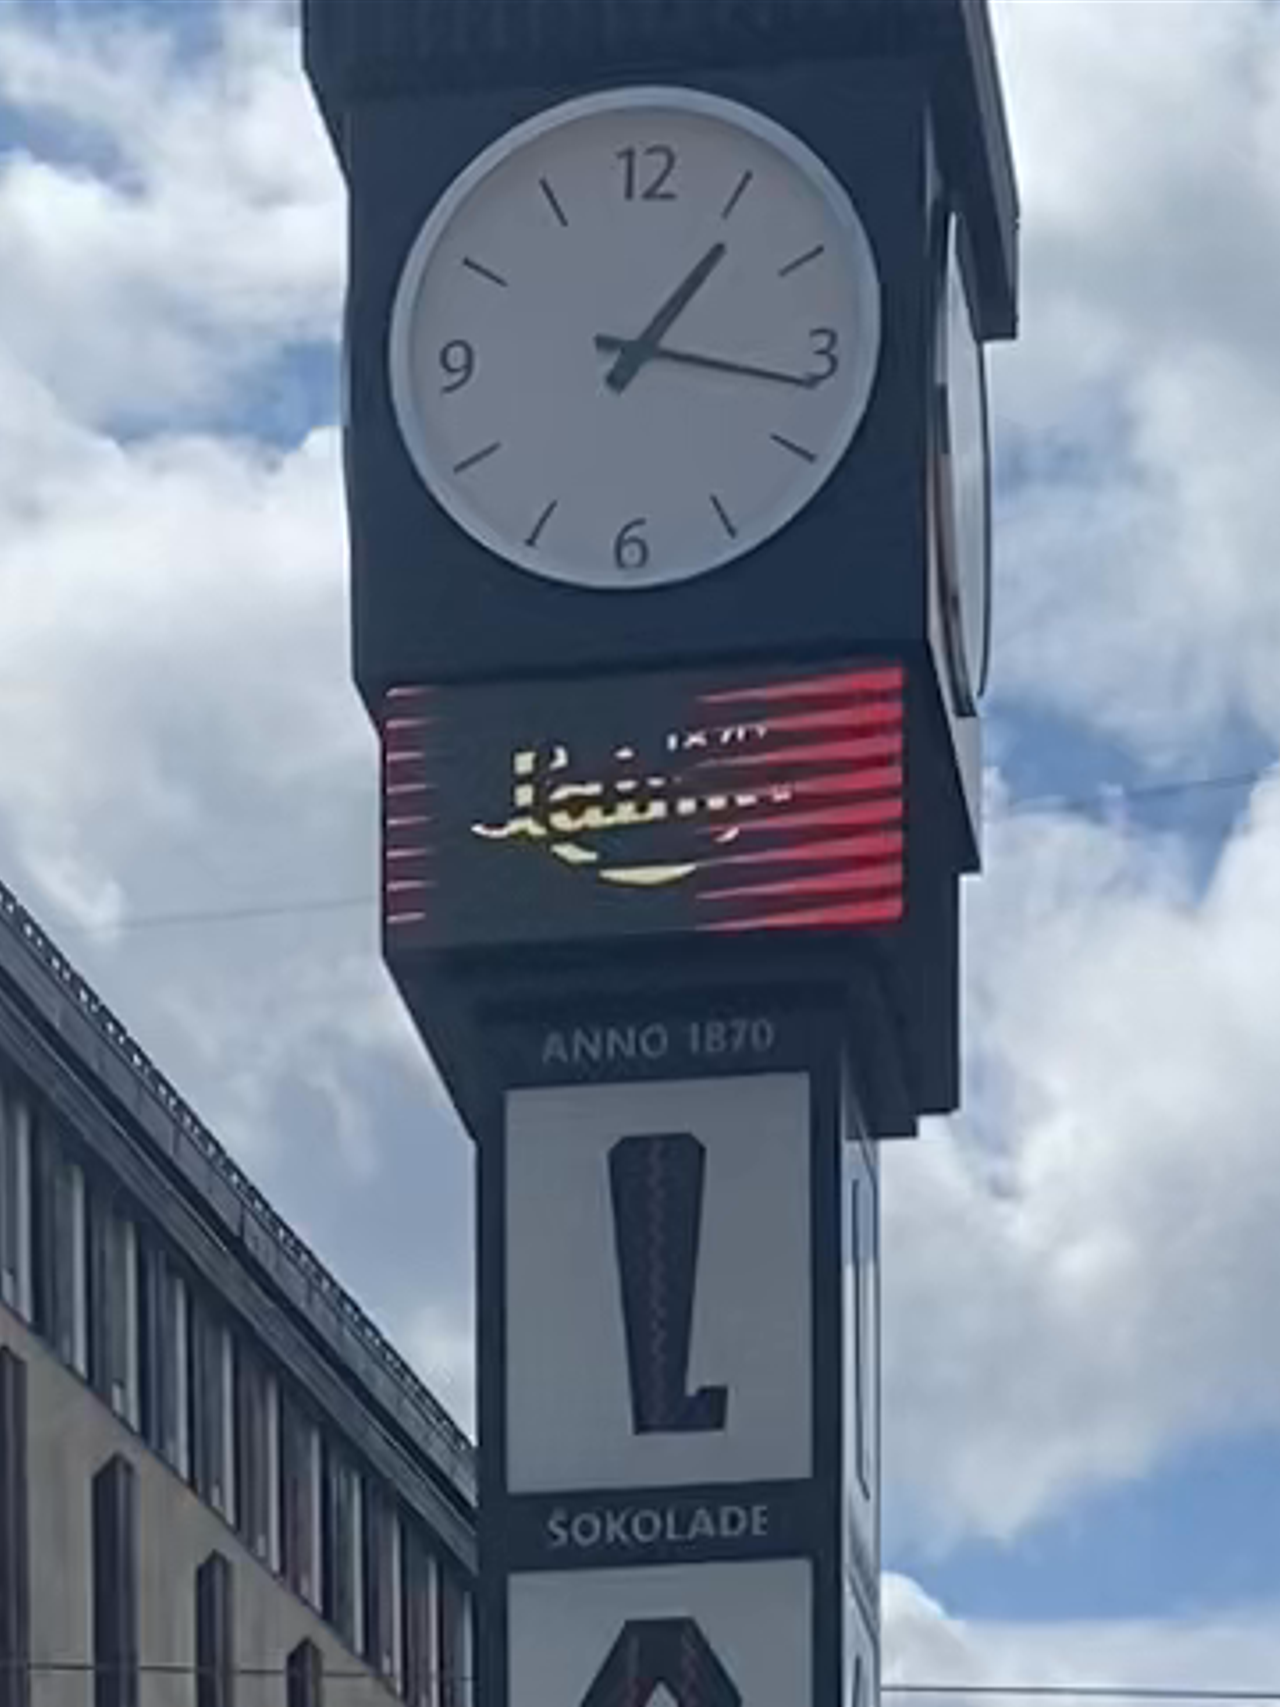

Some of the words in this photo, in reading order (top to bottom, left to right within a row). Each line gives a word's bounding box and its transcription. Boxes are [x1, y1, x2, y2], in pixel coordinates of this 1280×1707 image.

[616, 143, 678, 201] 12
[438, 339, 475, 394] 9
[807, 327, 840, 384] 3
[612, 517, 649, 569] 6
[541, 1025, 668, 1065] ANNO
[687, 1018, 775, 1054] 1870
[606, 1131, 729, 1436] L
[547, 1503, 770, 1548] ŠOKOLADE
